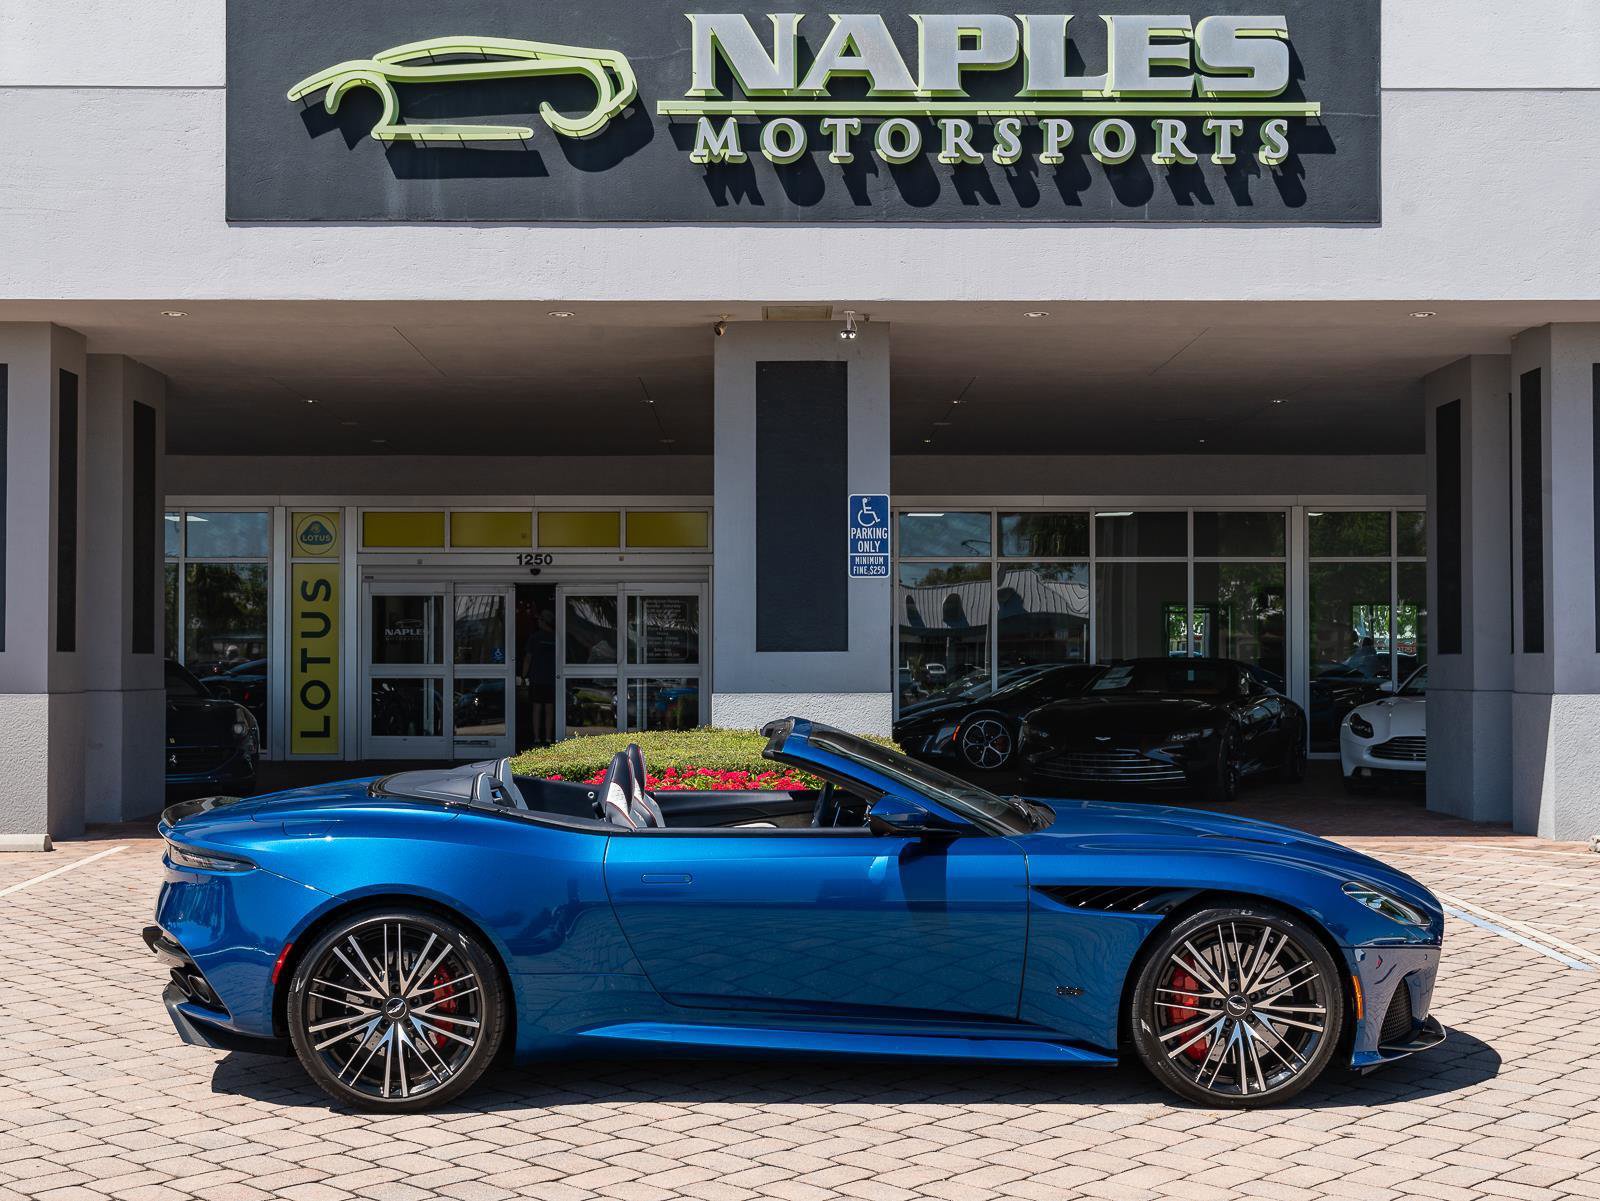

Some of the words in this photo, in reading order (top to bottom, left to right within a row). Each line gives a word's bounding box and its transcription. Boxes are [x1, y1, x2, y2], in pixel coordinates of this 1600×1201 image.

[684, 13, 1290, 98] NAPLES
[689, 116, 1289, 165] MOTORSPORTS
[302, 534, 331, 542] LOTUS
[850, 527, 888, 539] PARKING
[857, 541, 881, 553] ONLY
[516, 553, 553, 566] 1250
[855, 556, 884, 565] MINIMUM
[853, 566, 867, 575] FINE
[869, 566, 886, 575] $250
[384, 628, 425, 636] NAPLE
[300, 577, 332, 739] LOTUS
